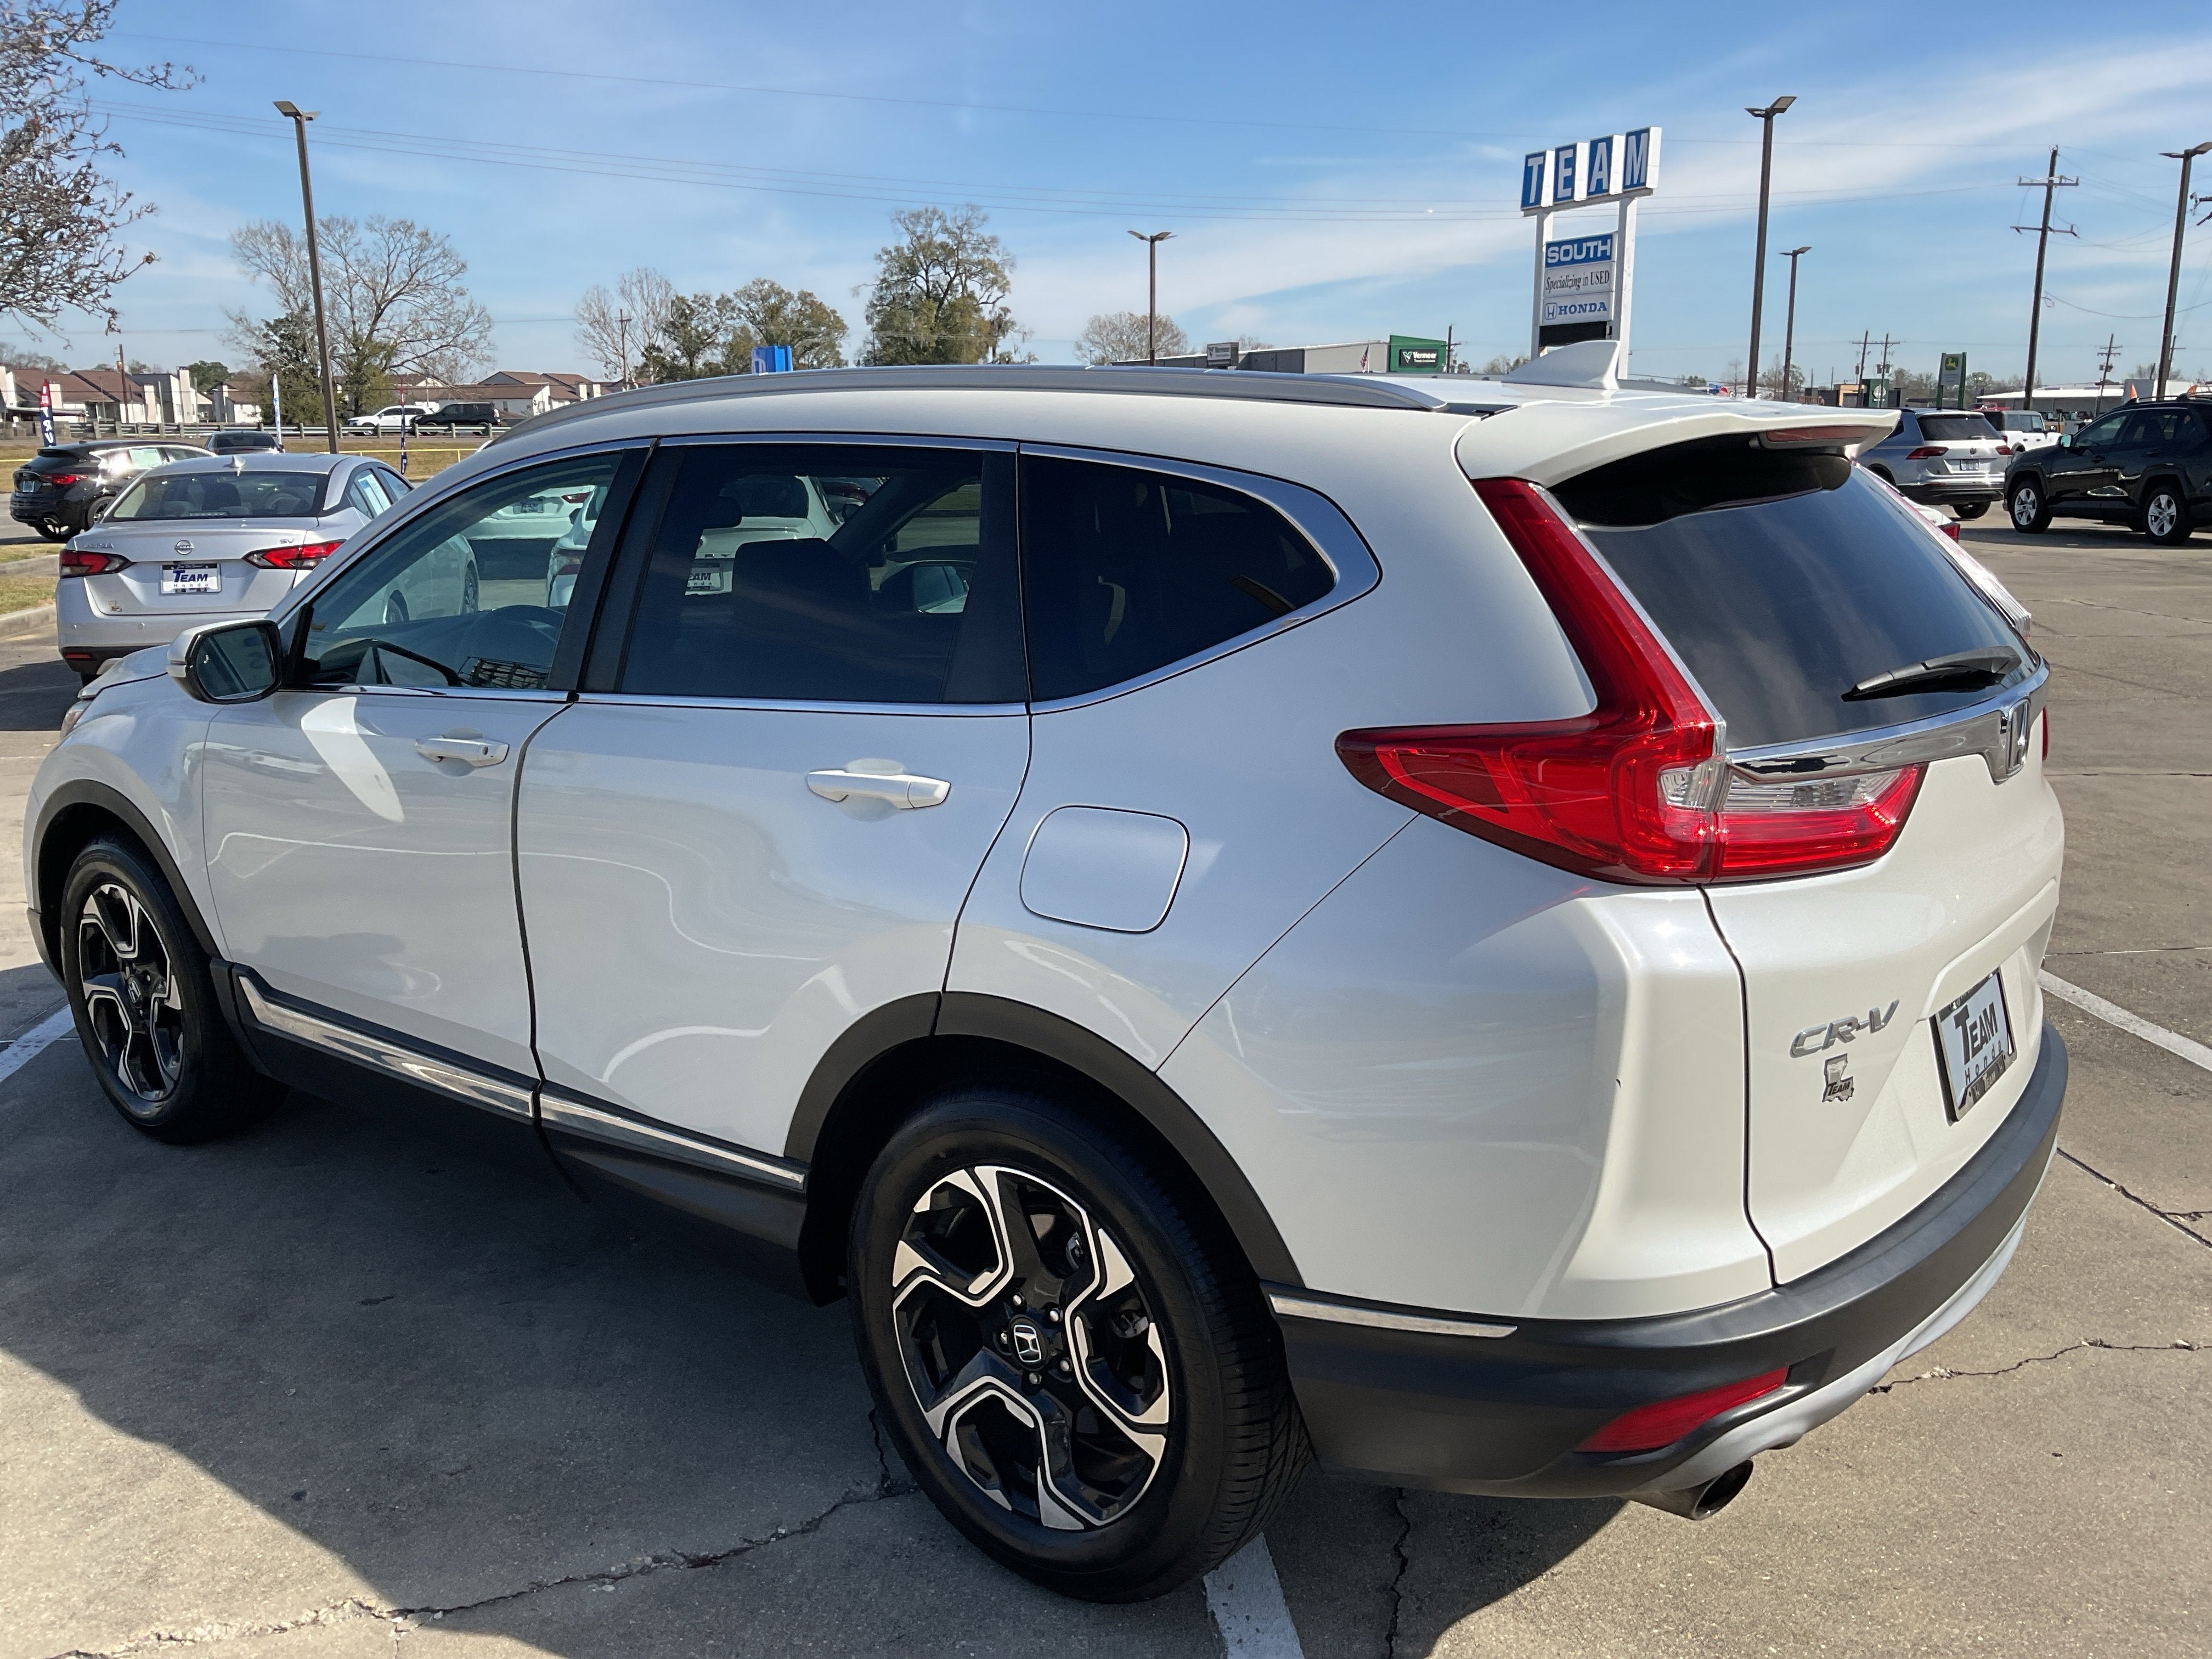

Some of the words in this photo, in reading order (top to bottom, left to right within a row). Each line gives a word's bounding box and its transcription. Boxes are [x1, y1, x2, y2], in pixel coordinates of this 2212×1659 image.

[1527, 133, 1649, 204] TEAM
[1547, 239, 1611, 264] SOUTH
[1545, 274, 1582, 294] Specializing
[1582, 272, 1589, 286] in
[1590, 270, 1610, 285] USED
[1558, 302, 1607, 315] HONDA
[173, 570, 208, 582] TEAM
[1790, 999, 1899, 1058] CR-V
[1953, 1002, 1997, 1065] TEAM
[1965, 1040, 2001, 1085] Honda
[1827, 1081, 1850, 1096] TEAM
[1982, 1070, 1996, 1091] TEAM
